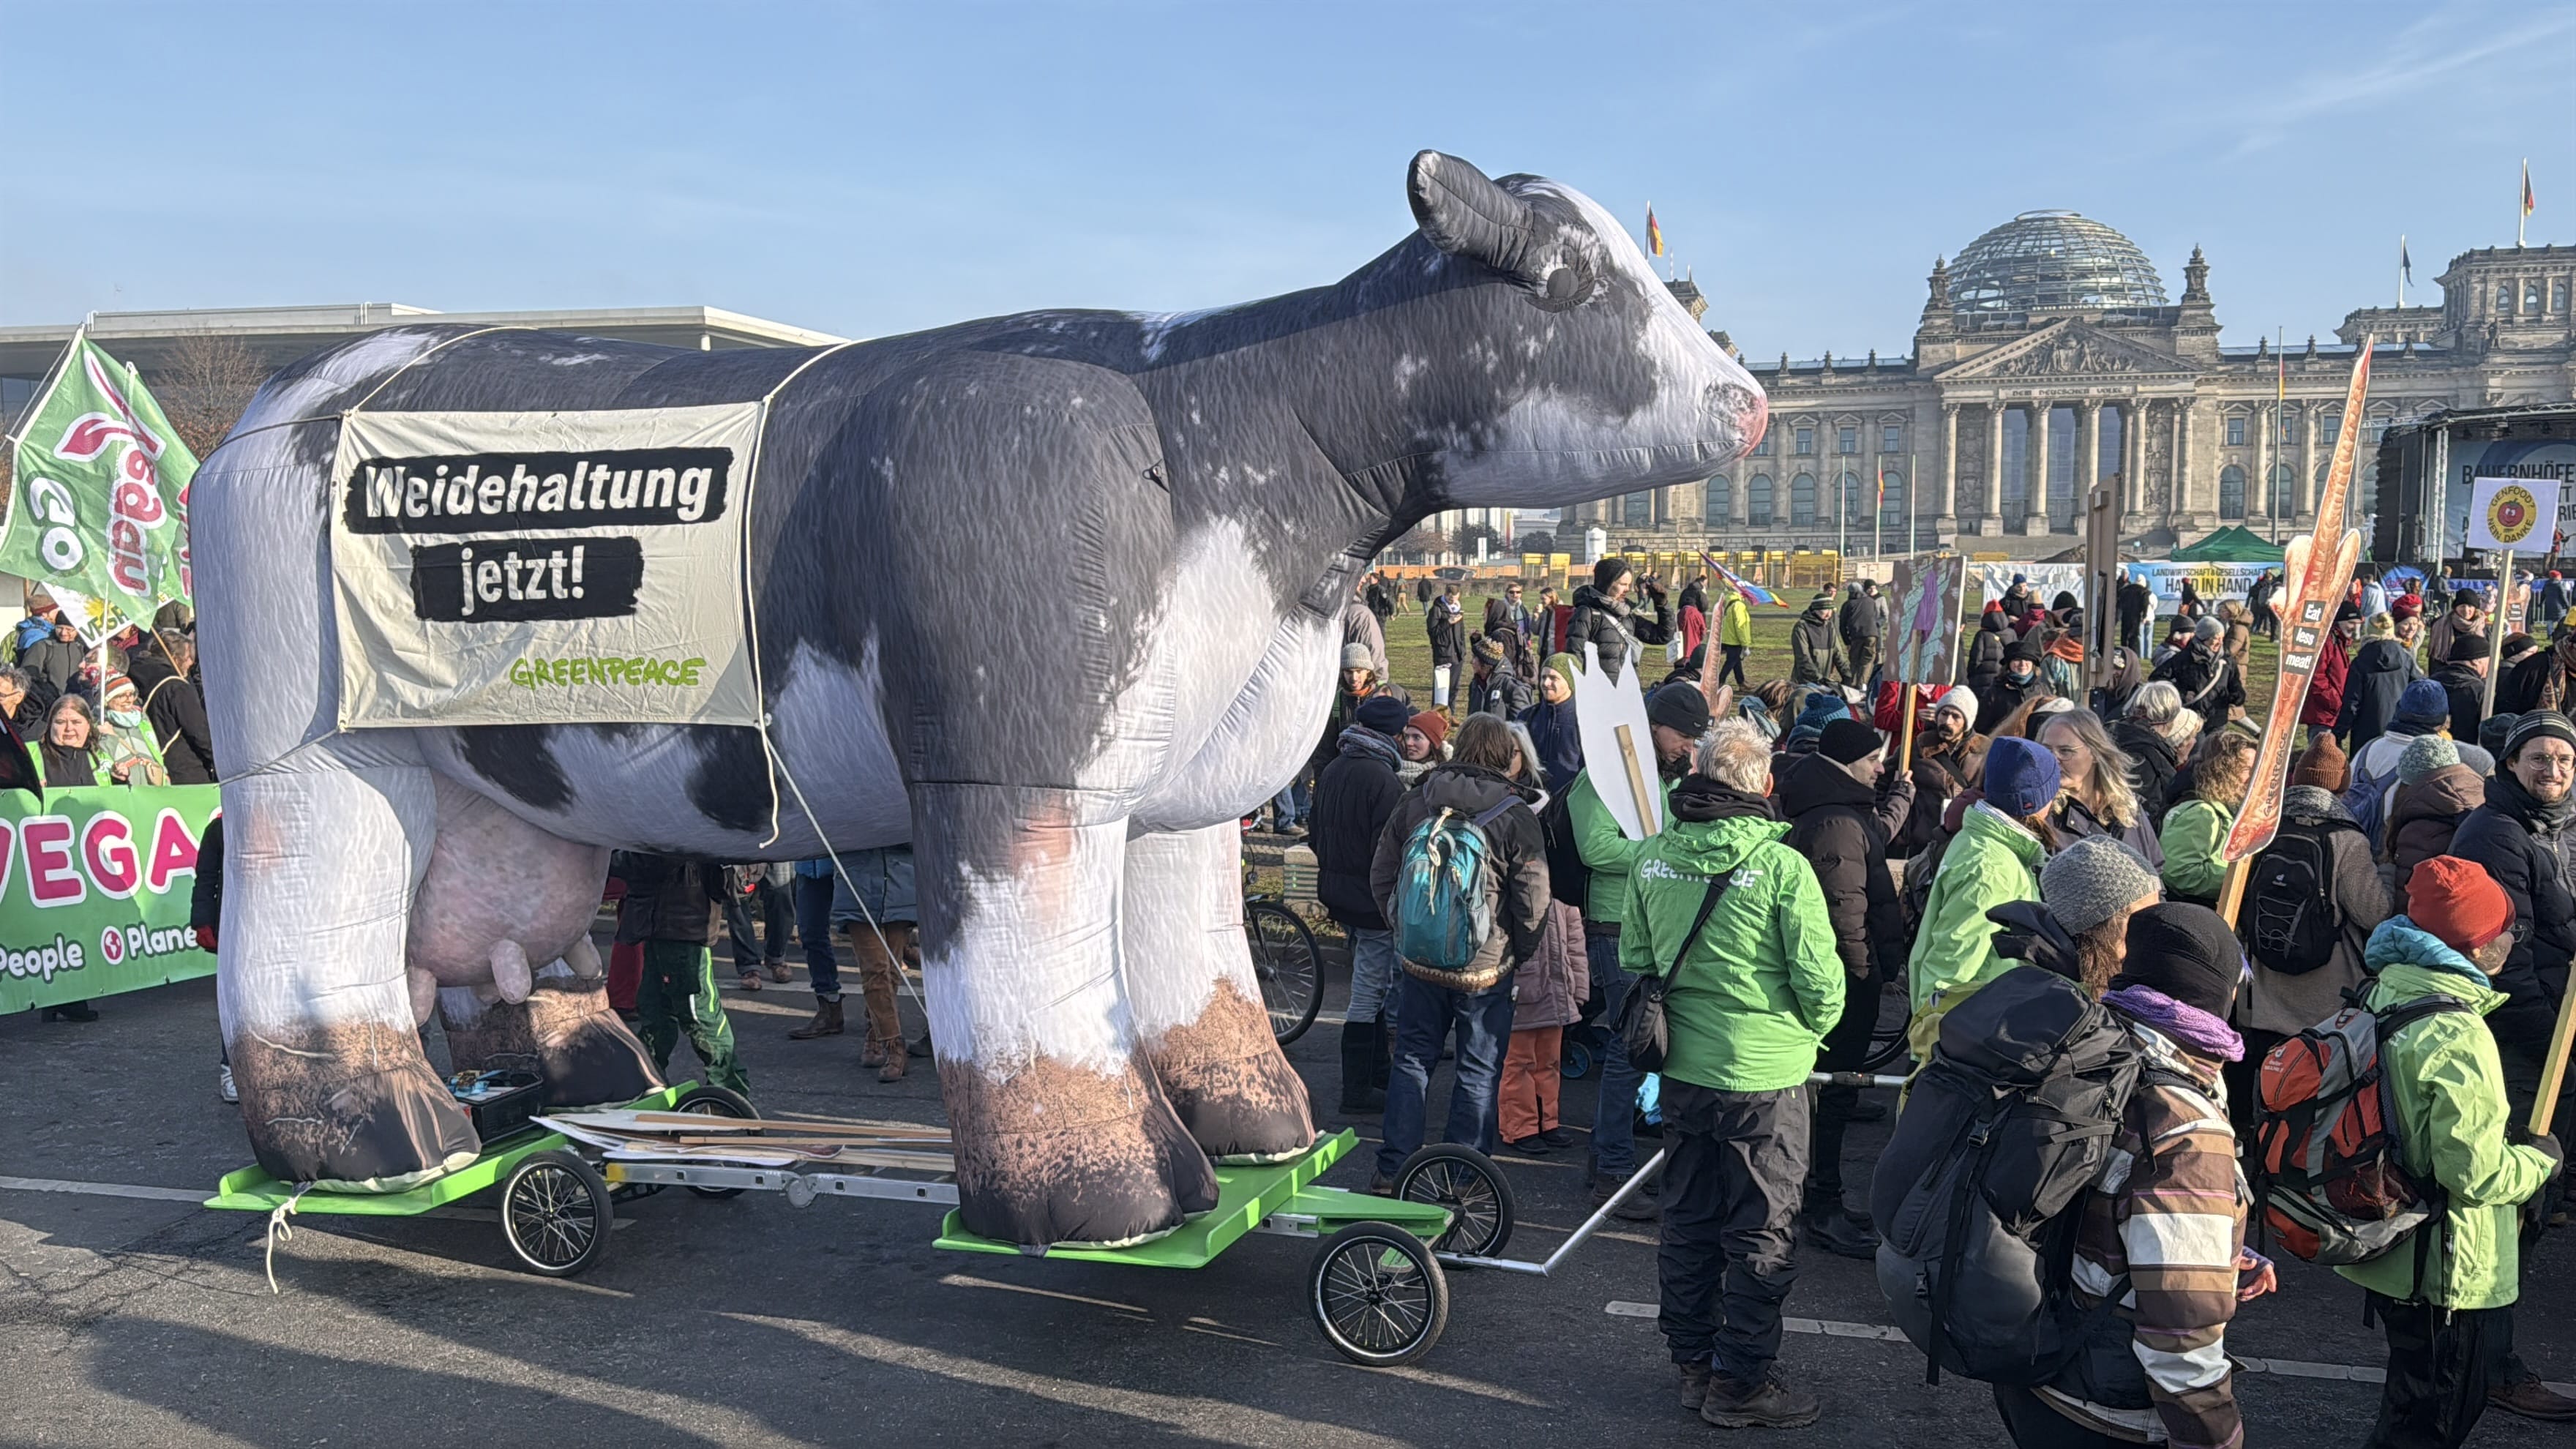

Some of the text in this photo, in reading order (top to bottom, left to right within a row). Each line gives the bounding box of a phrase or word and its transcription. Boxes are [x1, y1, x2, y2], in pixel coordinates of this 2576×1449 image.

[365, 461, 712, 522] Weidehaltung
[2491, 486, 2535, 508] GENFOOD?
[2487, 517, 2502, 539] NEIN
[2504, 519, 2533, 543] DANKE
[460, 544, 585, 616] jetzt!
[2152, 568, 2210, 577] LANDWIRTSCHAFT
[2165, 577, 2252, 593] HAD IN HAND
[2304, 603, 2321, 621] Eat
[2296, 627, 2315, 645] less
[510, 657, 707, 689] GREENPEACE
[2285, 654, 2313, 670] meat!
[2263, 728, 2288, 817] GREENPEACE
[0, 807, 222, 907] EGA
[127, 924, 198, 957] Plane
